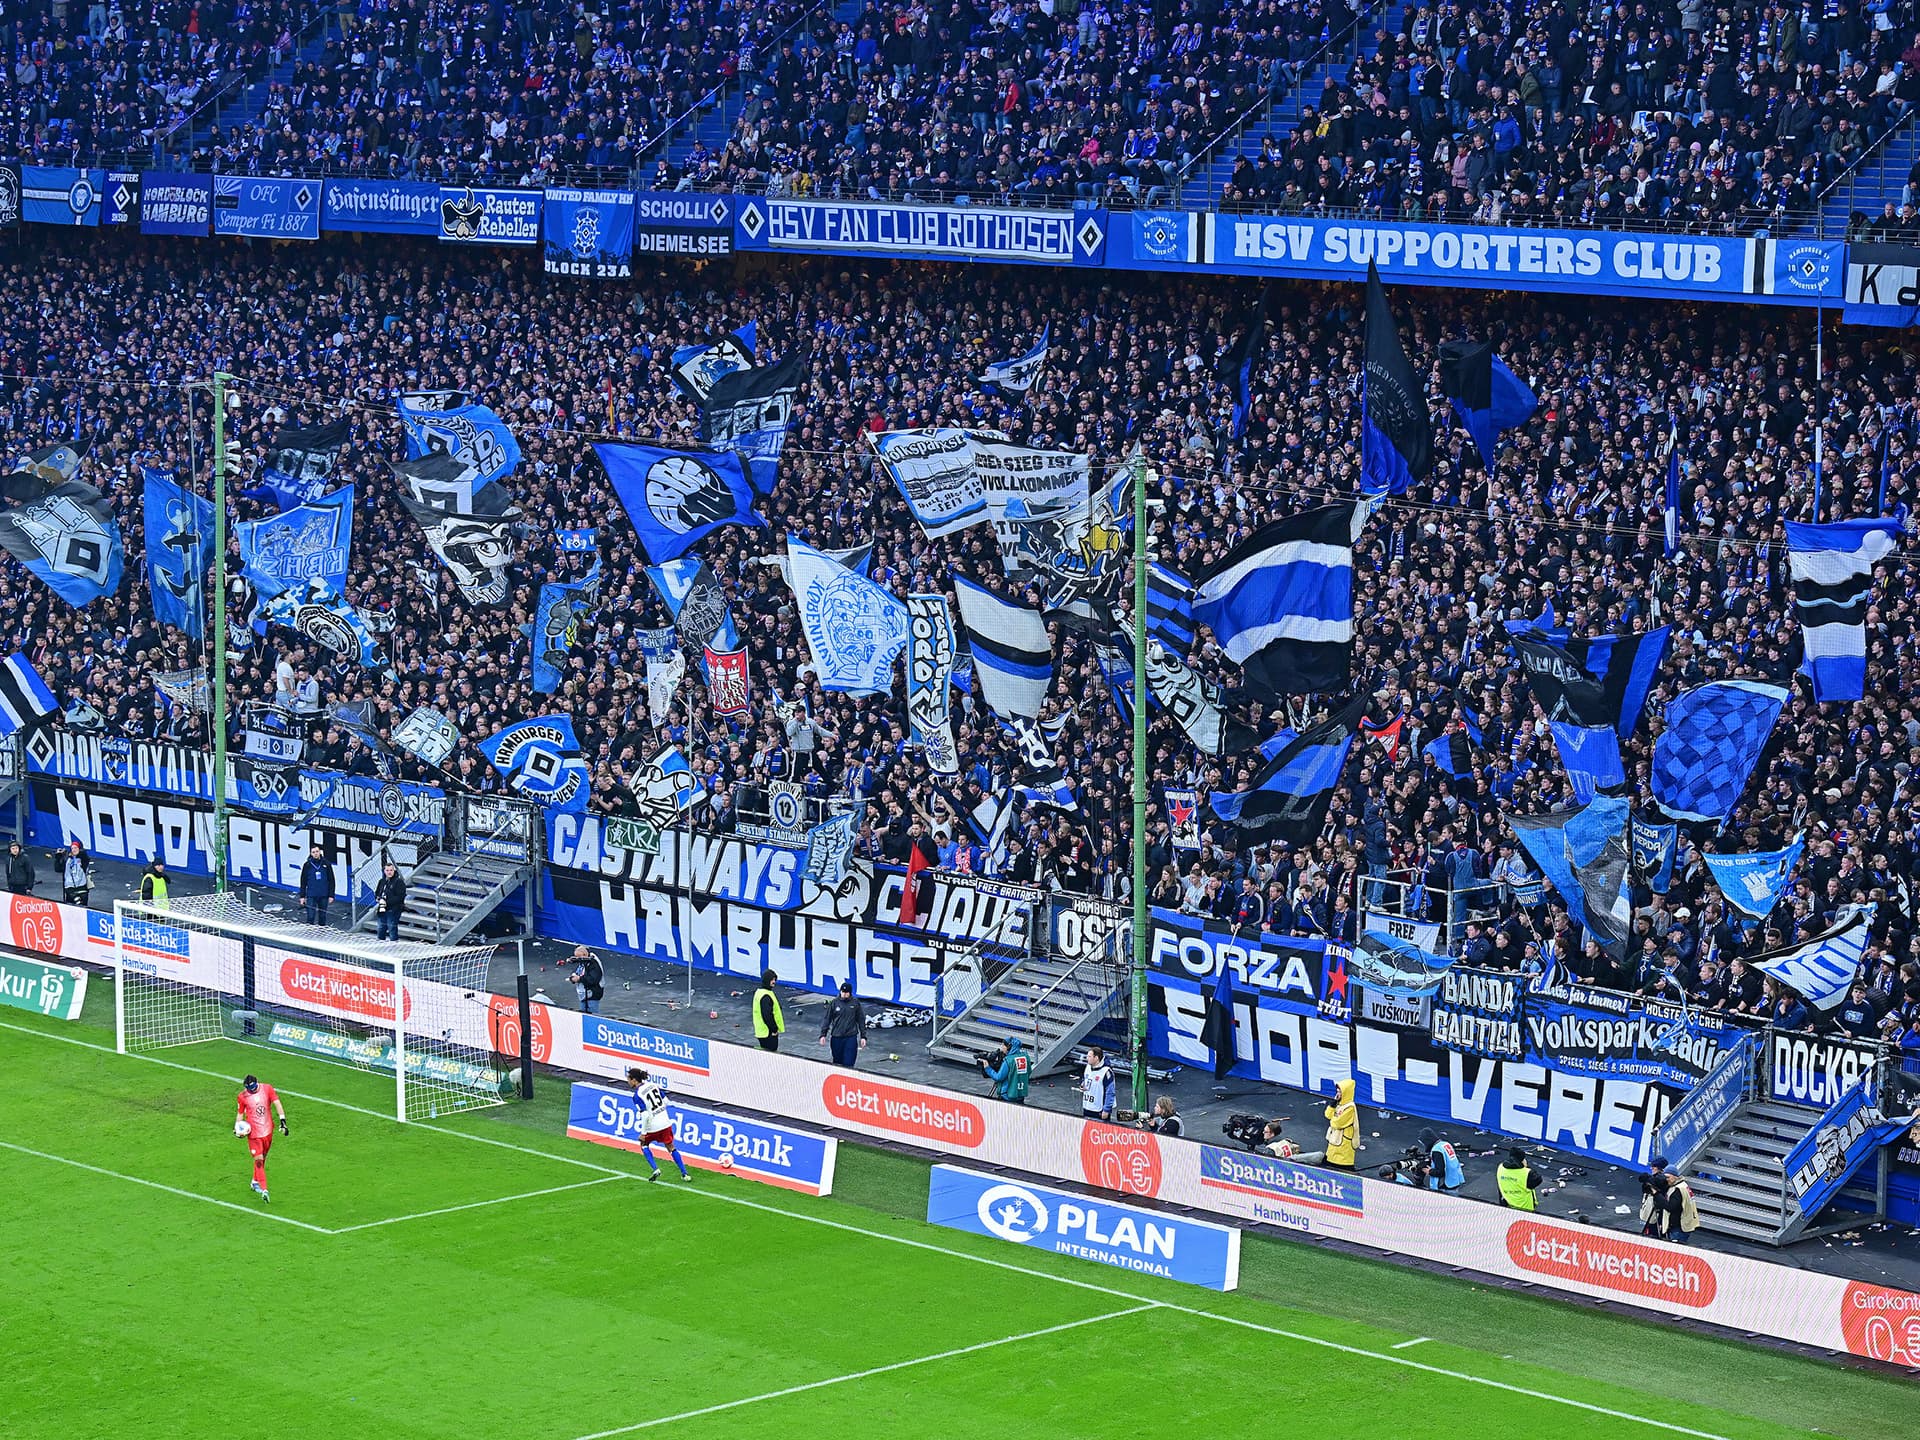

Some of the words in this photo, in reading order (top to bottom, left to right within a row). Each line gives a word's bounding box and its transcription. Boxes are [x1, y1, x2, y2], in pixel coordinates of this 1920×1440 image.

[250, 184, 281, 204] OFC
[327, 185, 439, 218] Hafensänger
[485, 194, 535, 215] Rauten
[545, 189, 582, 202] UNITED
[585, 191, 616, 204] FAMILY
[618, 194, 634, 205] HH
[143, 204, 208, 223] HAMBURG
[640, 198, 709, 220] SCHOLLI
[217, 210, 258, 233] Semper
[261, 214, 276, 230] Fi
[279, 215, 310, 231] 1887
[478, 215, 538, 238] Rebellen
[769, 206, 816, 238] HSV
[825, 207, 871, 241] FAN
[877, 208, 939, 244] CLUB
[947, 213, 1073, 254] ROTHOSEN
[640, 232, 730, 253] DIEMELSEE
[1234, 222, 1314, 260] HSV
[1323, 227, 1601, 276] SUPPORTERS
[1612, 239, 1722, 282] CLUB
[544, 259, 591, 276] BLOCK
[597, 265, 630, 277] 23A
[1005, 455, 1043, 472] SIEG
[1047, 454, 1075, 469] IST
[496, 727, 564, 766] HAMBURGER
[54, 731, 103, 780] IRON
[127, 742, 216, 797] LOYALTY
[779, 800, 793, 818] 12
[1633, 836, 1661, 851] MERDA
[553, 814, 797, 907] CASTAWAYS
[932, 873, 976, 887] ULTRAS
[977, 882, 997, 894] FREE
[15, 900, 53, 914] Girokonto
[1073, 898, 1119, 919] HAMBURG
[99, 917, 178, 950] Sprda-Bank
[1388, 921, 1415, 940] FREE
[928, 940, 943, 949] DU
[122, 955, 157, 975] Hamburg
[1150, 927, 1314, 995] FORZA
[290, 967, 326, 994] Jetzt
[1444, 972, 1515, 1015] BANDA
[1588, 989, 1628, 1013] immer!
[1645, 1002, 1686, 1023] HOLSTE
[1698, 1016, 1725, 1030] CREW
[273, 1021, 307, 1041] bet365
[310, 1032, 345, 1050] bet365
[597, 1023, 694, 1061] Sparda-Bank
[347, 1040, 383, 1058] bet365
[386, 1047, 422, 1067] be365
[425, 1057, 460, 1075] bet365
[1164, 987, 1674, 1165] SORT-VEREI
[1559, 1055, 1586, 1072] SPIELE,
[1588, 1060, 1609, 1074] SIEGE
[1611, 1063, 1617, 1073] &
[1619, 1064, 1662, 1078] EMOTIONEN
[1671, 1072, 1688, 1083] SEIT
[646, 1088, 662, 1111] 15
[836, 1084, 879, 1115] Jetzt
[883, 1099, 972, 1136] wechseln
[597, 1095, 793, 1168] Spada-Bank
[1090, 1128, 1148, 1147] Girokonto
[1220, 1157, 1344, 1200] Sparda-Bank
[1792, 1151, 1828, 1197] ELB
[1254, 1204, 1310, 1230] Hamburg
[1057, 1203, 1175, 1259] PLAN
[1056, 1240, 1172, 1277] INTERNATIONAL
[1523, 1231, 1579, 1267] Jetzt
[1586, 1249, 1700, 1292] wechseln
